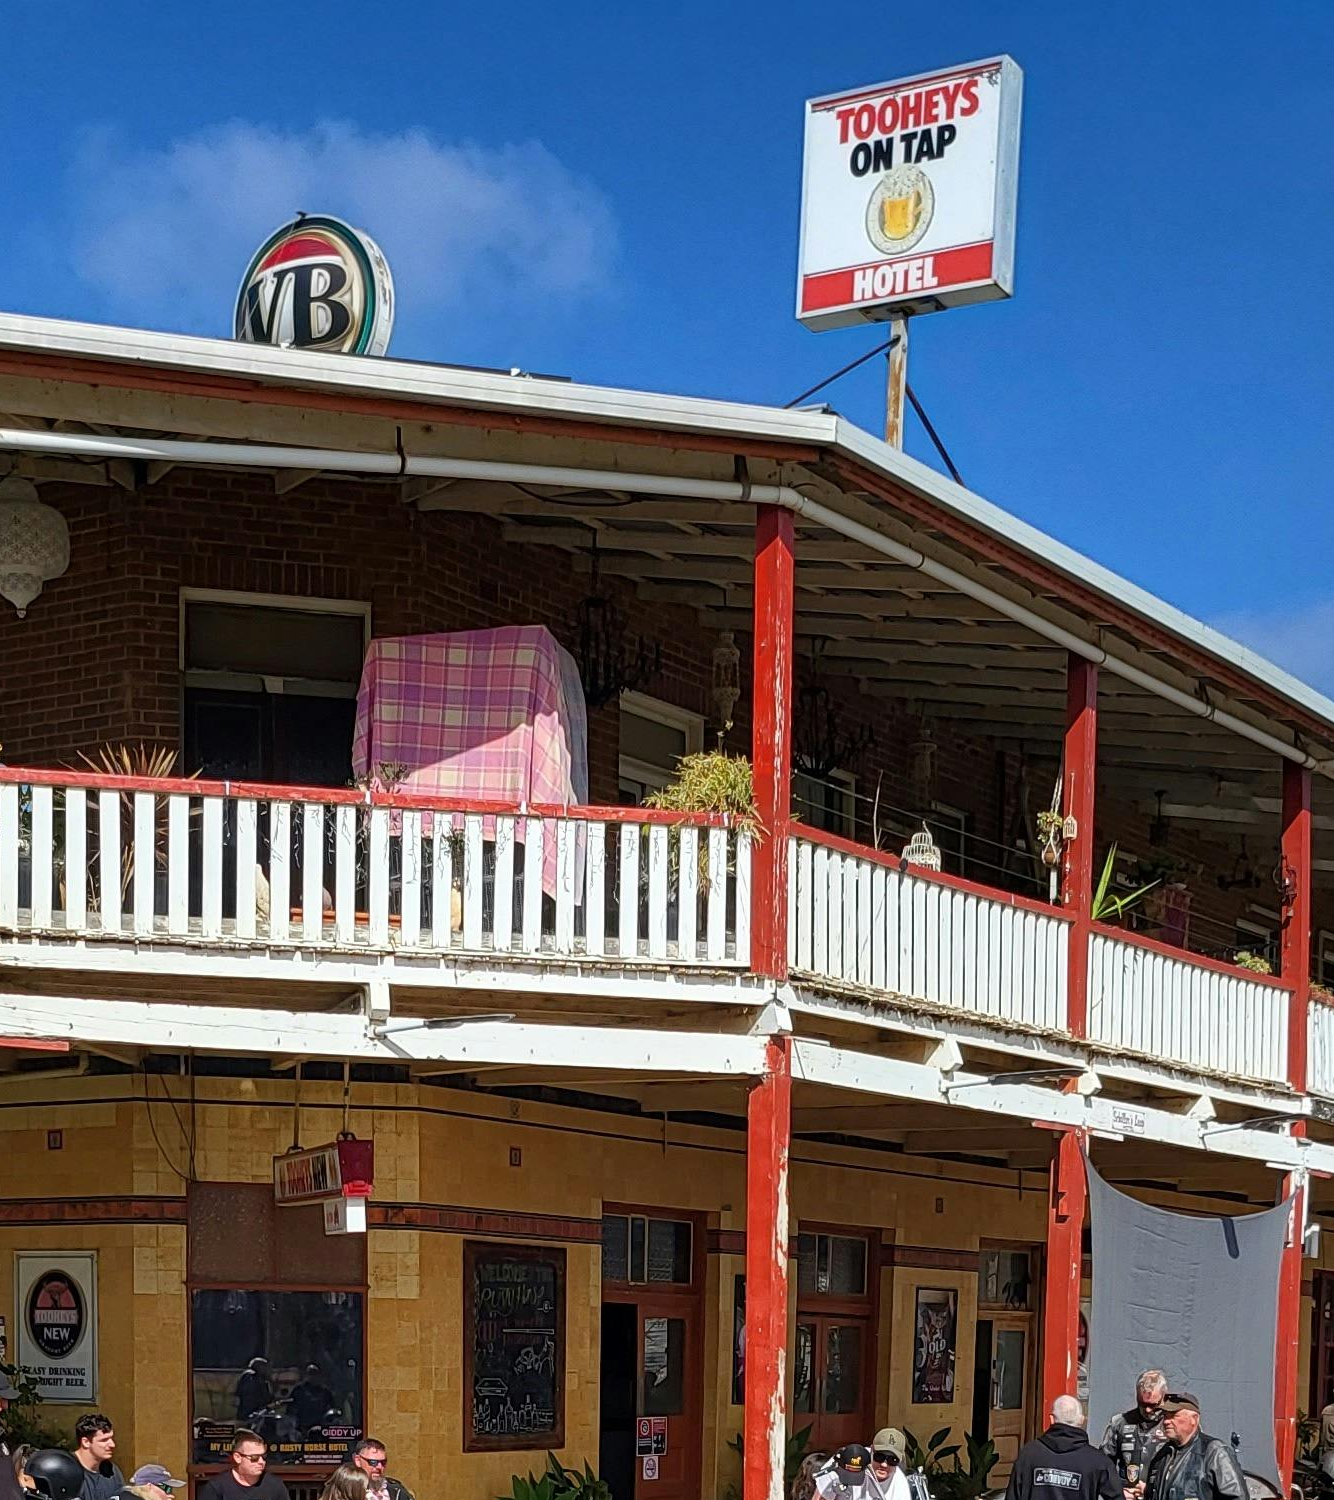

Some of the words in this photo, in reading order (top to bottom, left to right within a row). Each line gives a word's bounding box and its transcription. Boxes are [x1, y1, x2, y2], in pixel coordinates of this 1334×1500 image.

[836, 78, 980, 144] TOOHEYS
[850, 136, 893, 178] ON
[900, 123, 957, 165] TAP
[852, 256, 939, 302] HOTEL
[246, 262, 352, 347] VB
[43, 1327, 71, 1341] NEW
[48, 1366, 86, 1377] DRINKING
[279, 1443, 302, 1452] RUSTY
[321, 1428, 348, 1437] GIDDY
[349, 1429, 363, 1437] UP
